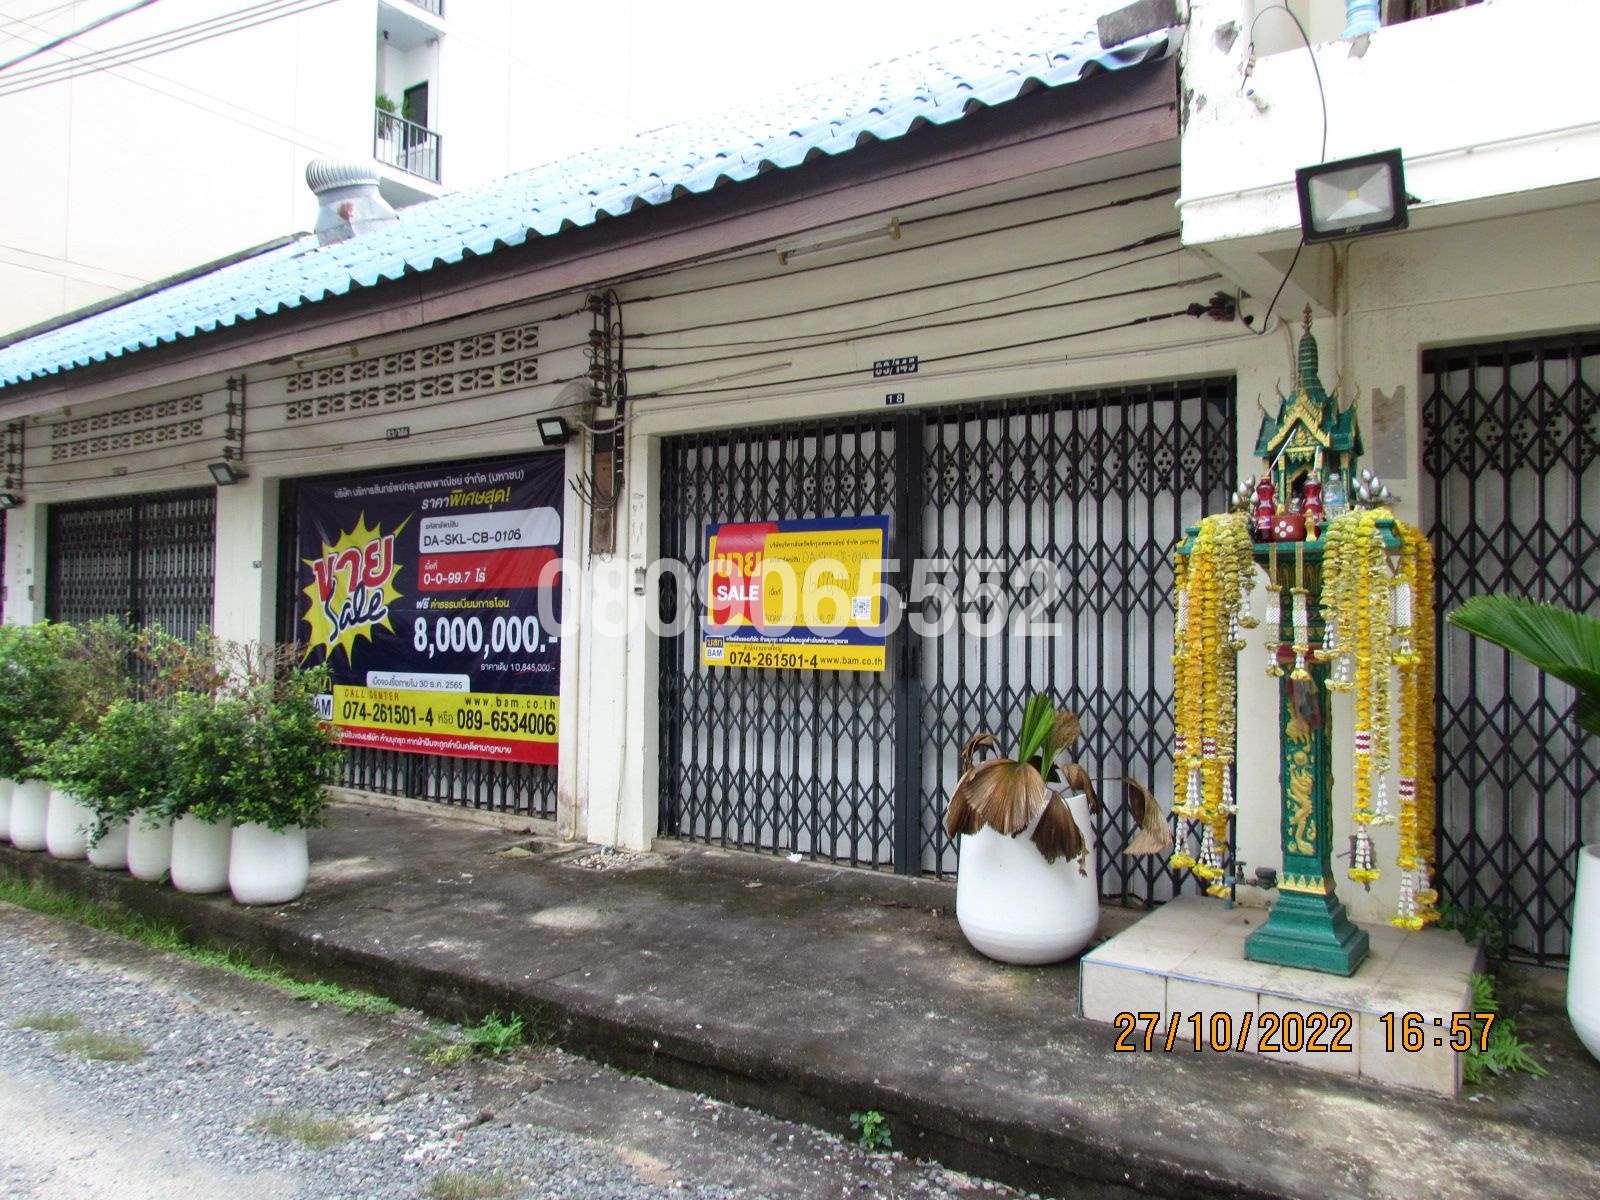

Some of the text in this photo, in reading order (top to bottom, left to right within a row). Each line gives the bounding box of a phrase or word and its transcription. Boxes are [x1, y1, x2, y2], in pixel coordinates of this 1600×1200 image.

[887, 394, 903, 404] 18
[334, 488, 353, 499] บริษัท
[464, 473, 487, 485] จำกัด
[488, 469, 524, 485] (มหาชน)
[424, 528, 521, 547] DA-SKL-CB-0106
[313, 534, 394, 603] ขาย
[717, 551, 762, 578] ขาย
[423, 567, 486, 585] 0-0-99.7 ไร่
[717, 585, 759, 601] SALE
[323, 579, 388, 643] Sale
[416, 596, 510, 610] ฟรี ค่าธรรมเนียมการโอน
[707, 649, 723, 657] BAM
[729, 651, 883, 668] 074-261501-4 www.bam.co.th
[480, 661, 508, 671] ราคาเดิม
[419, 680, 428, 688] 30
[445, 681, 463, 689] 2565
[344, 688, 400, 701] CALL CENTER
[343, 700, 557, 736] 074-261501-4 หรือ 089-6534006
